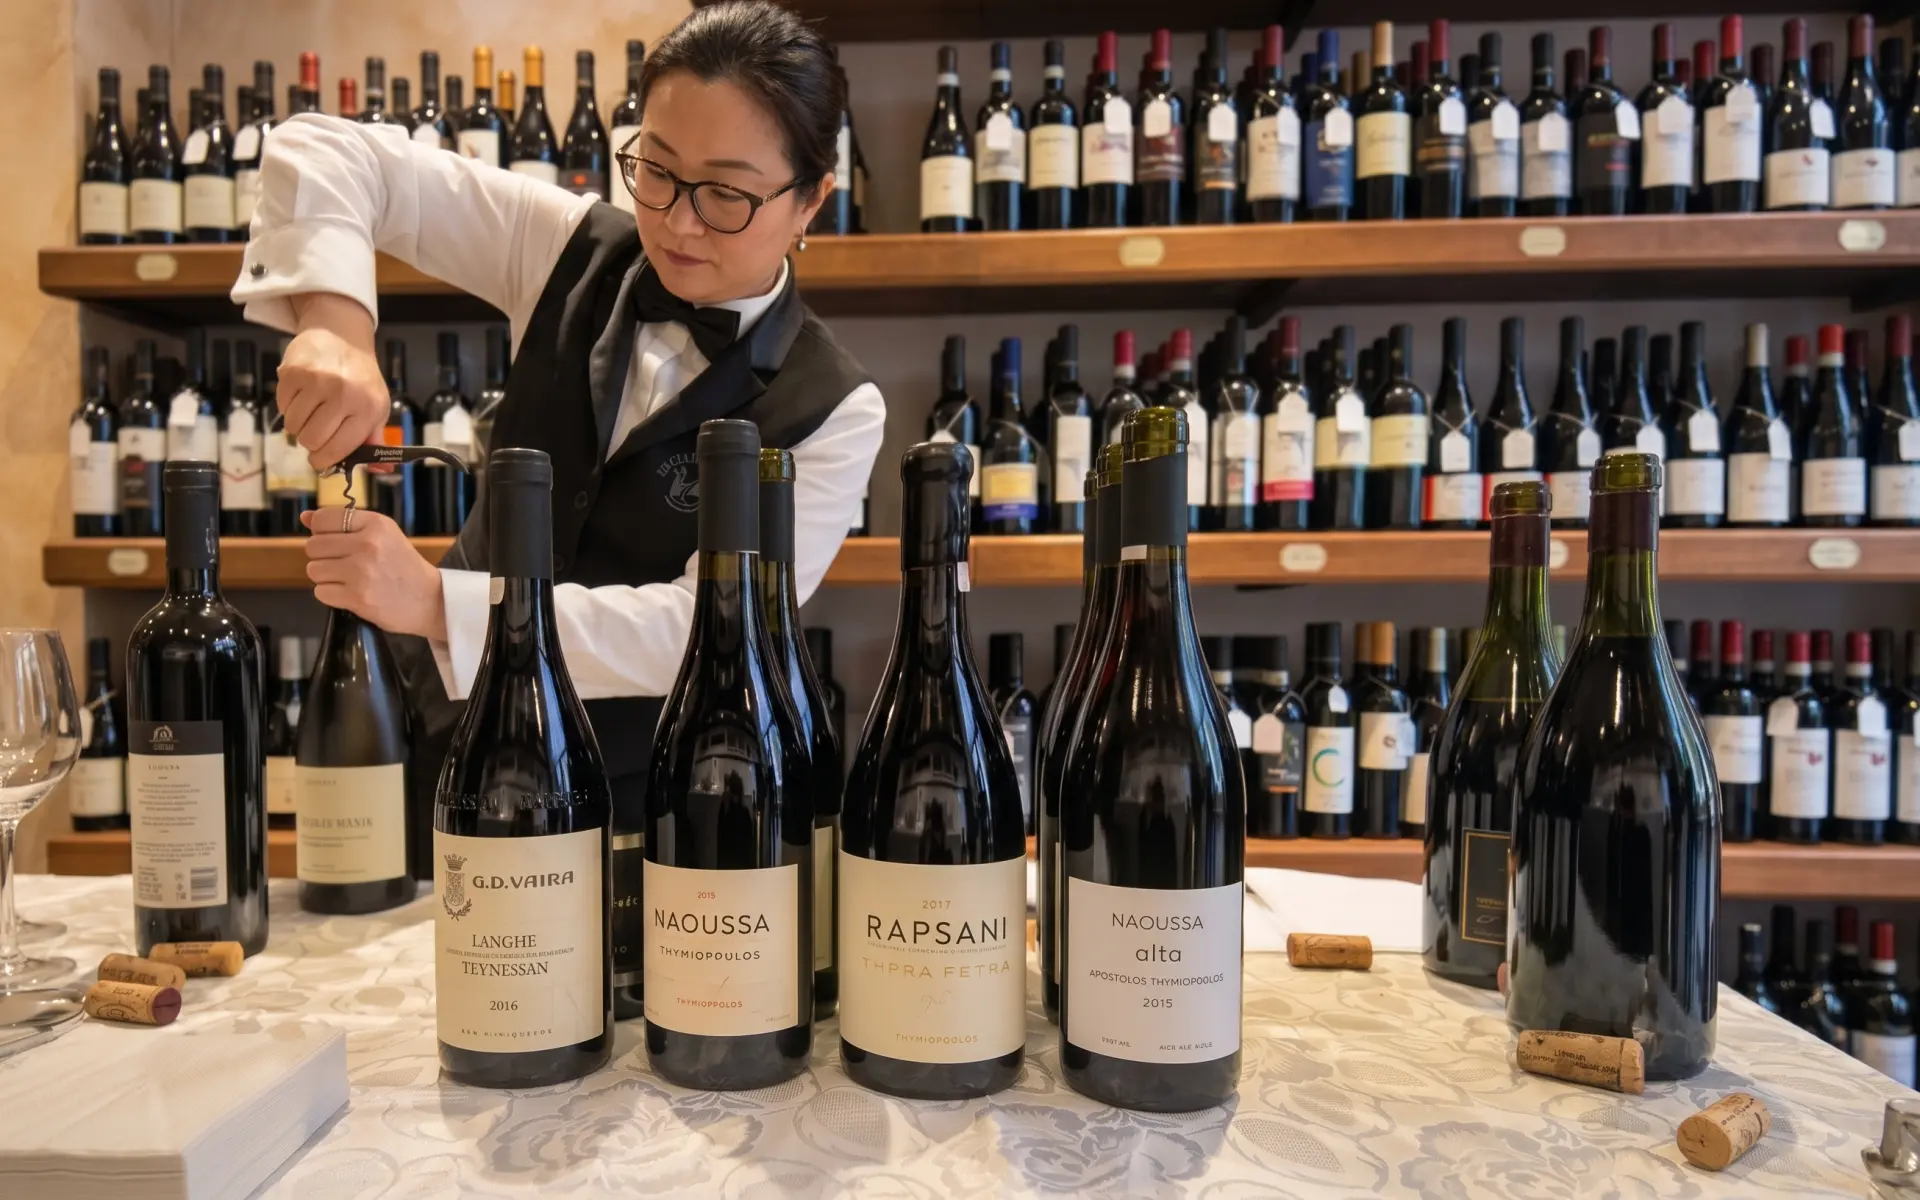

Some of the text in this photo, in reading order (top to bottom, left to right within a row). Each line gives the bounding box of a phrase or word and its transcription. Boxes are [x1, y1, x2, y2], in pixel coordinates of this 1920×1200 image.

[472, 870, 574, 889] G.D.VAIRA
[697, 891, 716, 899] 2015
[922, 900, 951, 909] 2017
[655, 907, 770, 935] NAOUSSA
[1112, 912, 1204, 931] NAOUSSA
[867, 914, 1007, 945] RAPSANI
[471, 934, 537, 949] LANGHE
[660, 945, 761, 961] THYMIOPOULOS
[1135, 944, 1181, 962] alta
[461, 961, 549, 977] TEYNESSAN
[862, 956, 1011, 979] THPRA FETRA
[1089, 969, 1147, 986] APOSTOLOS
[489, 1000, 518, 1011] 2016
[1142, 998, 1173, 1008] 2015
